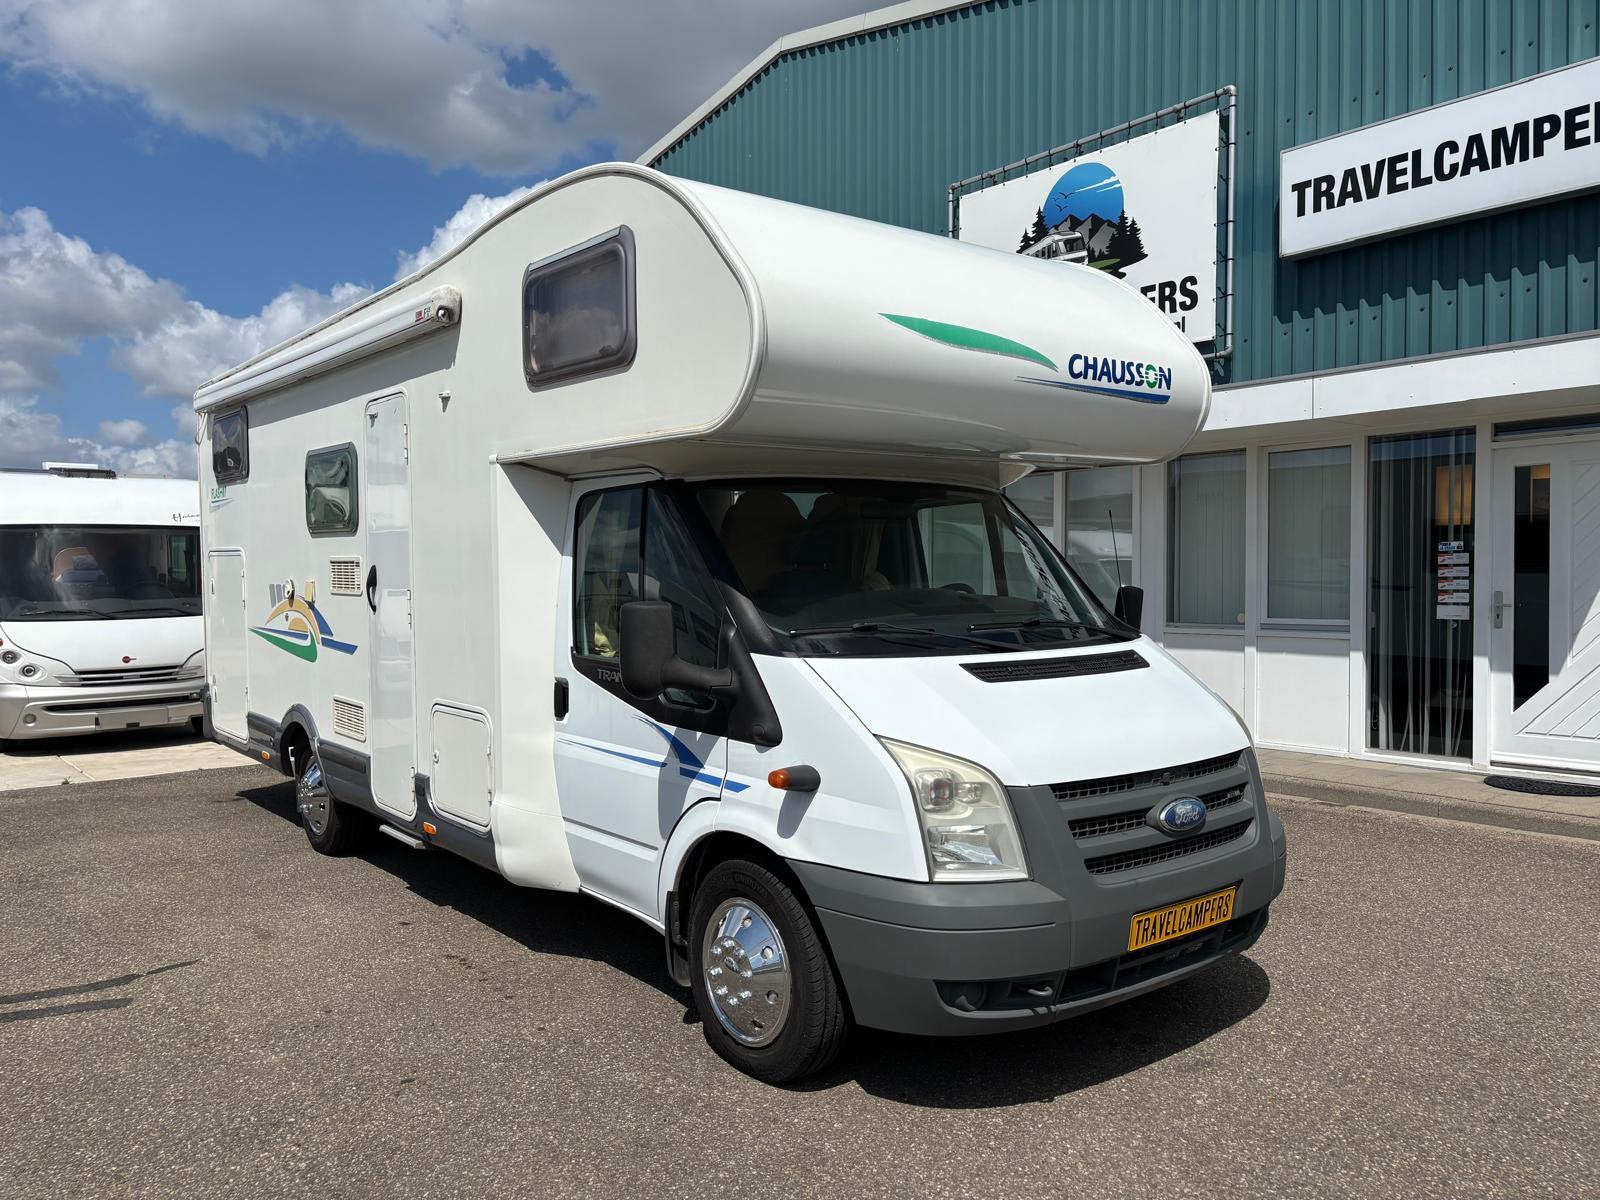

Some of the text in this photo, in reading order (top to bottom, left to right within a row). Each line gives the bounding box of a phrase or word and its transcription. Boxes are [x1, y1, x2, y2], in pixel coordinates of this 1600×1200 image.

[1291, 101, 1600, 218] TRAVELCAMPE
[1068, 353, 1172, 390] CHAUSSON
[1175, 804, 1200, 824] Ford
[1135, 893, 1231, 946] TRAVELCAMPERS
